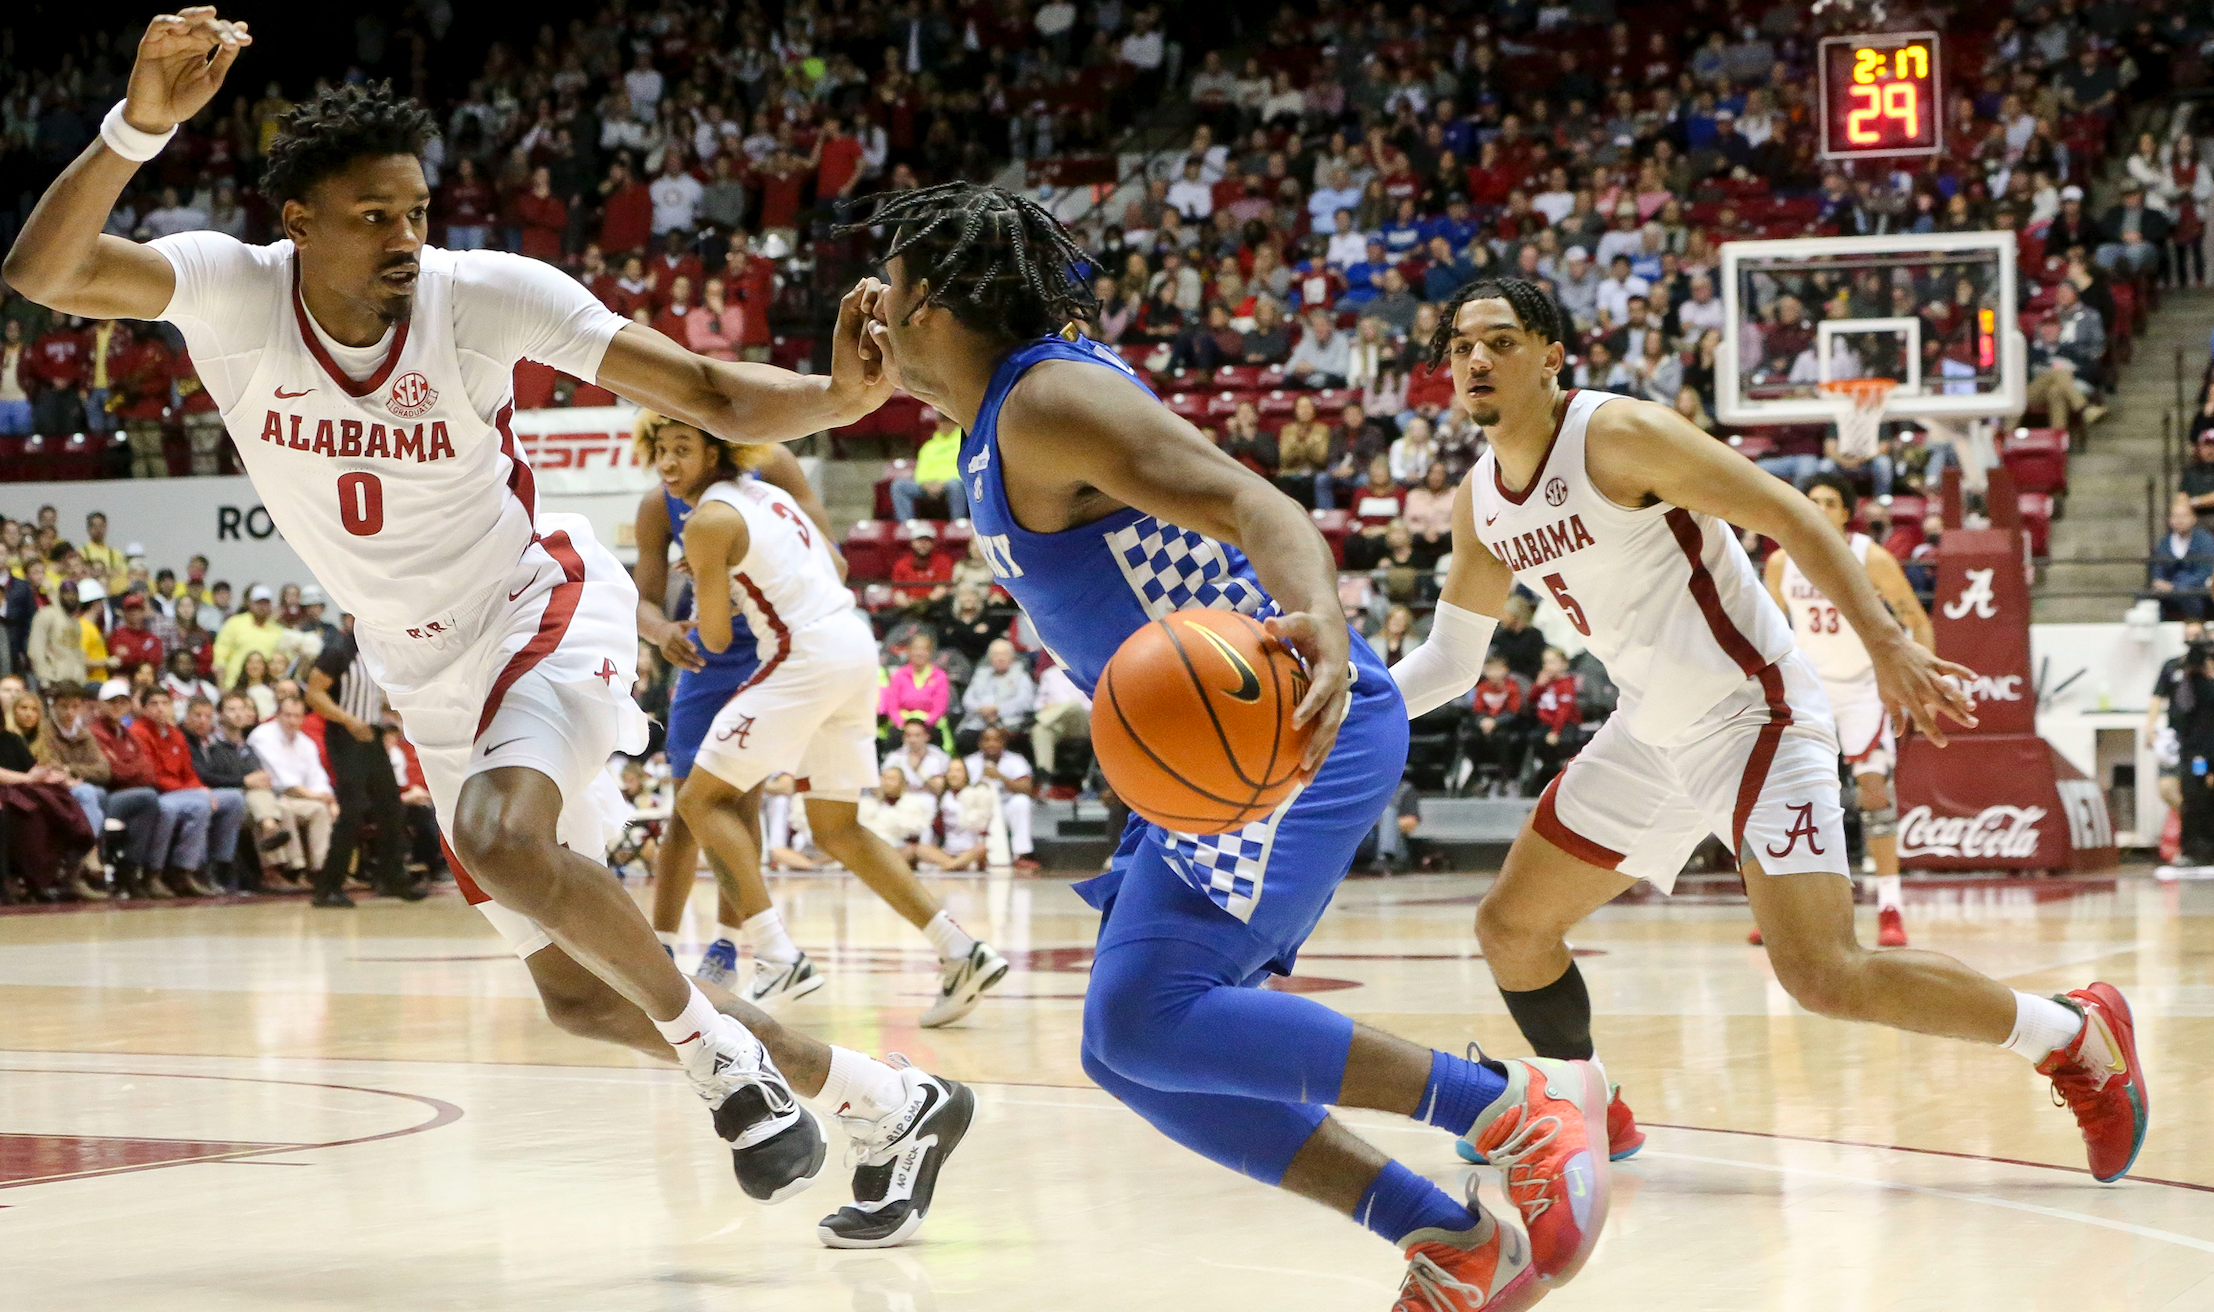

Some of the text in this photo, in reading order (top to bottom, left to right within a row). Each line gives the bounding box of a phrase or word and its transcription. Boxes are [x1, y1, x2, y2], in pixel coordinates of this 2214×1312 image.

[1853, 45, 1928, 84] 2:17
[1847, 82, 1919, 144] 29
[392, 398, 434, 417] GRADUATE
[393, 373, 428, 407] SEC
[261, 409, 456, 463] ALABAMA
[337, 471, 384, 537] 0
[1545, 477, 1568, 507] SEC
[1542, 572, 1592, 637] 5
[1943, 567, 1998, 620] A
[1808, 606, 1840, 635] 33
[1961, 674, 2023, 702] PNC
[716, 713, 756, 750] A
[1766, 801, 1826, 859] A
[886, 1099, 923, 1143] RIP GMA
[897, 1145, 920, 1190] NO LUCK
